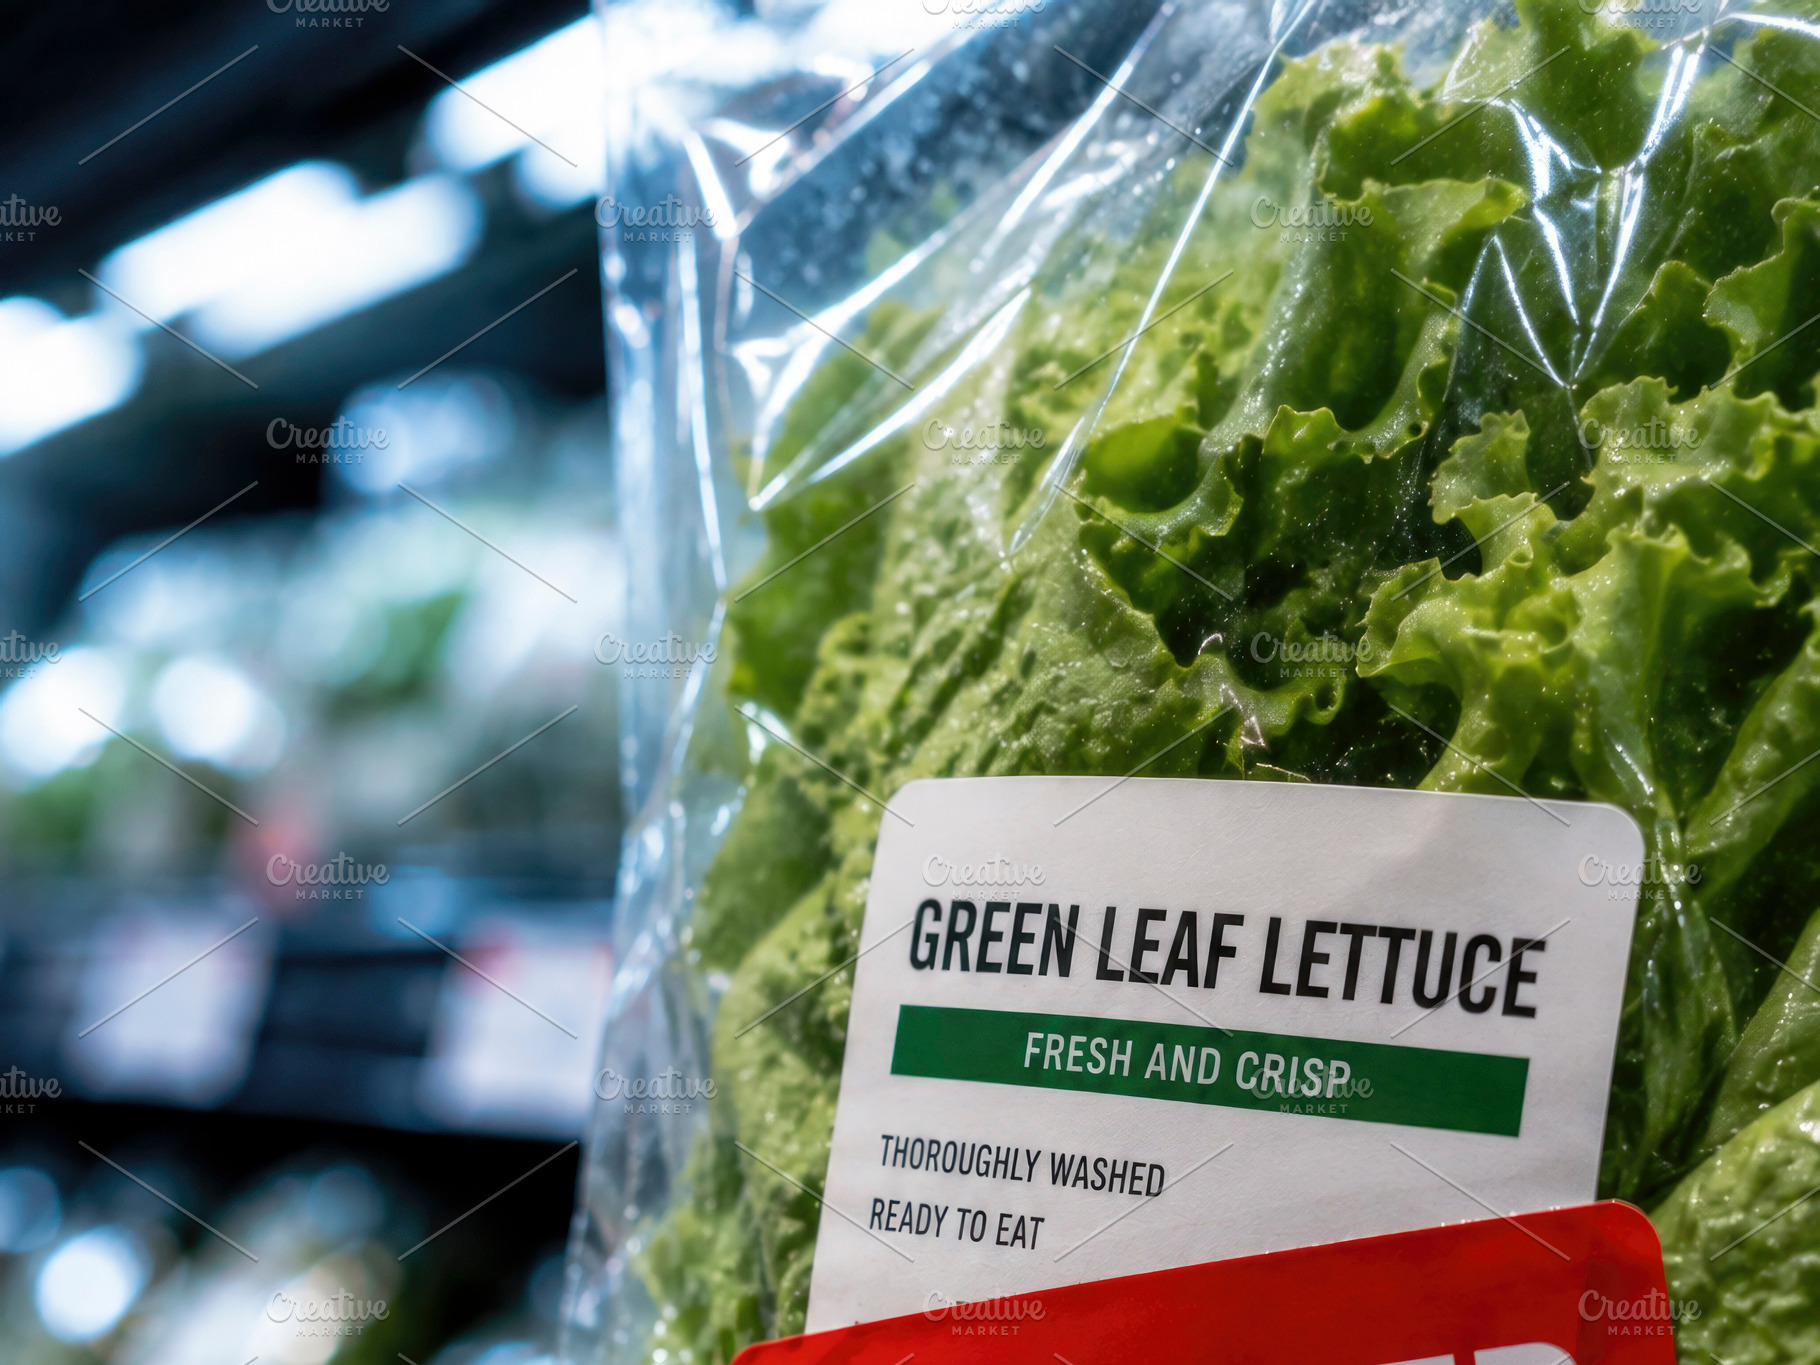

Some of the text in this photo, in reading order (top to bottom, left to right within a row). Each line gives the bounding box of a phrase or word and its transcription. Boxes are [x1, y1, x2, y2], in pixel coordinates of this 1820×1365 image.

[909, 898, 1547, 1019] GREEN LEAF LETTUCE
[1023, 1031, 1351, 1099] FRESH AND CRISP
[881, 1134, 1166, 1198] THOROUGHLY WASHED
[869, 1197, 1046, 1250] READY TO EAT
